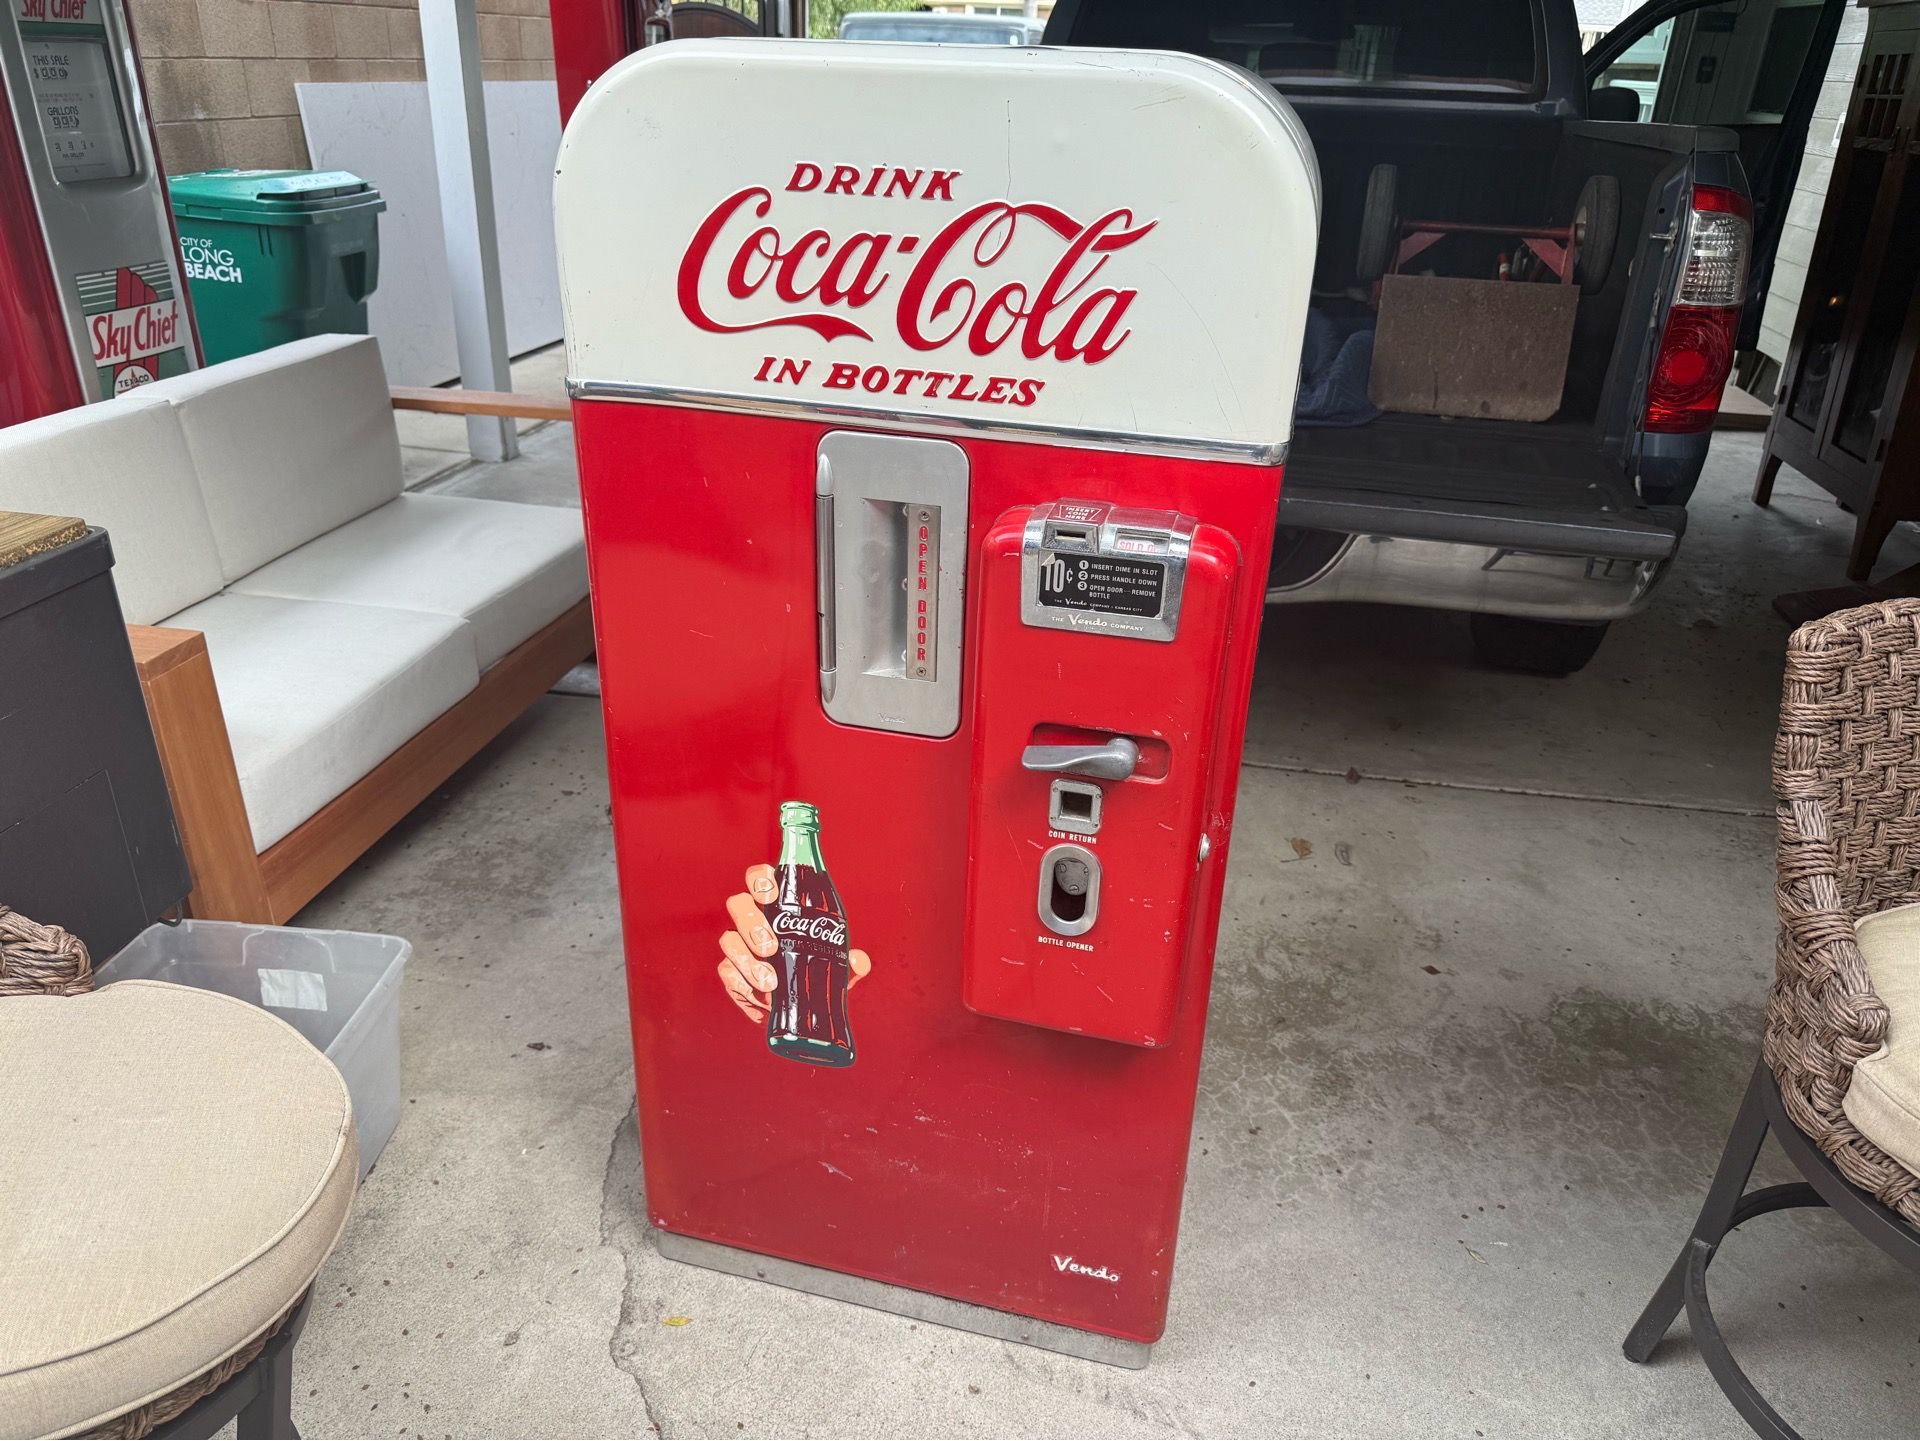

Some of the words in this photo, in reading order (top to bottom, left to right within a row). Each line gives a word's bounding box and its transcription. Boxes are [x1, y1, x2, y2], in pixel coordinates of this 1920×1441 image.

[47, 105, 80, 117] GALLONS
[785, 162, 962, 201] DRINK
[180, 236, 198, 247] CITY
[200, 239, 213, 248] OF
[181, 246, 234, 266] LONG
[184, 263, 243, 284] BEACH
[677, 184, 1160, 364] Coca-Cola
[93, 313, 132, 361] Sky
[134, 301, 179, 351] Chief
[118, 374, 150, 389] TEXACO
[754, 355, 811, 386] IN
[822, 361, 1047, 407] BOTTLES
[1065, 506, 1095, 514] INSERT
[918, 525, 928, 591] OPEN
[1091, 563, 1113, 571] INSERT
[1090, 573, 1110, 582] PRESS
[1112, 577, 1136, 585] HANDLE
[1138, 579, 1158, 587] DOWN
[1088, 592, 1111, 600] BOTTLE
[1089, 584, 1105, 592] OPEN
[1107, 586, 1124, 594] DOOR
[1131, 589, 1157, 598] REMOVE
[1065, 598, 1088, 606] Vendo
[917, 599, 927, 662] DOOR
[1067, 613, 1108, 627] Vendo
[1110, 623, 1145, 632] COMPANY
[1048, 830, 1066, 840] COIN
[1069, 834, 1097, 844] RETURN
[772, 911, 846, 946] Coca-Cola
[1038, 936, 1063, 947] BOTTLE
[1066, 941, 1094, 952] OPENER
[1053, 1255, 1119, 1282] Vendo
